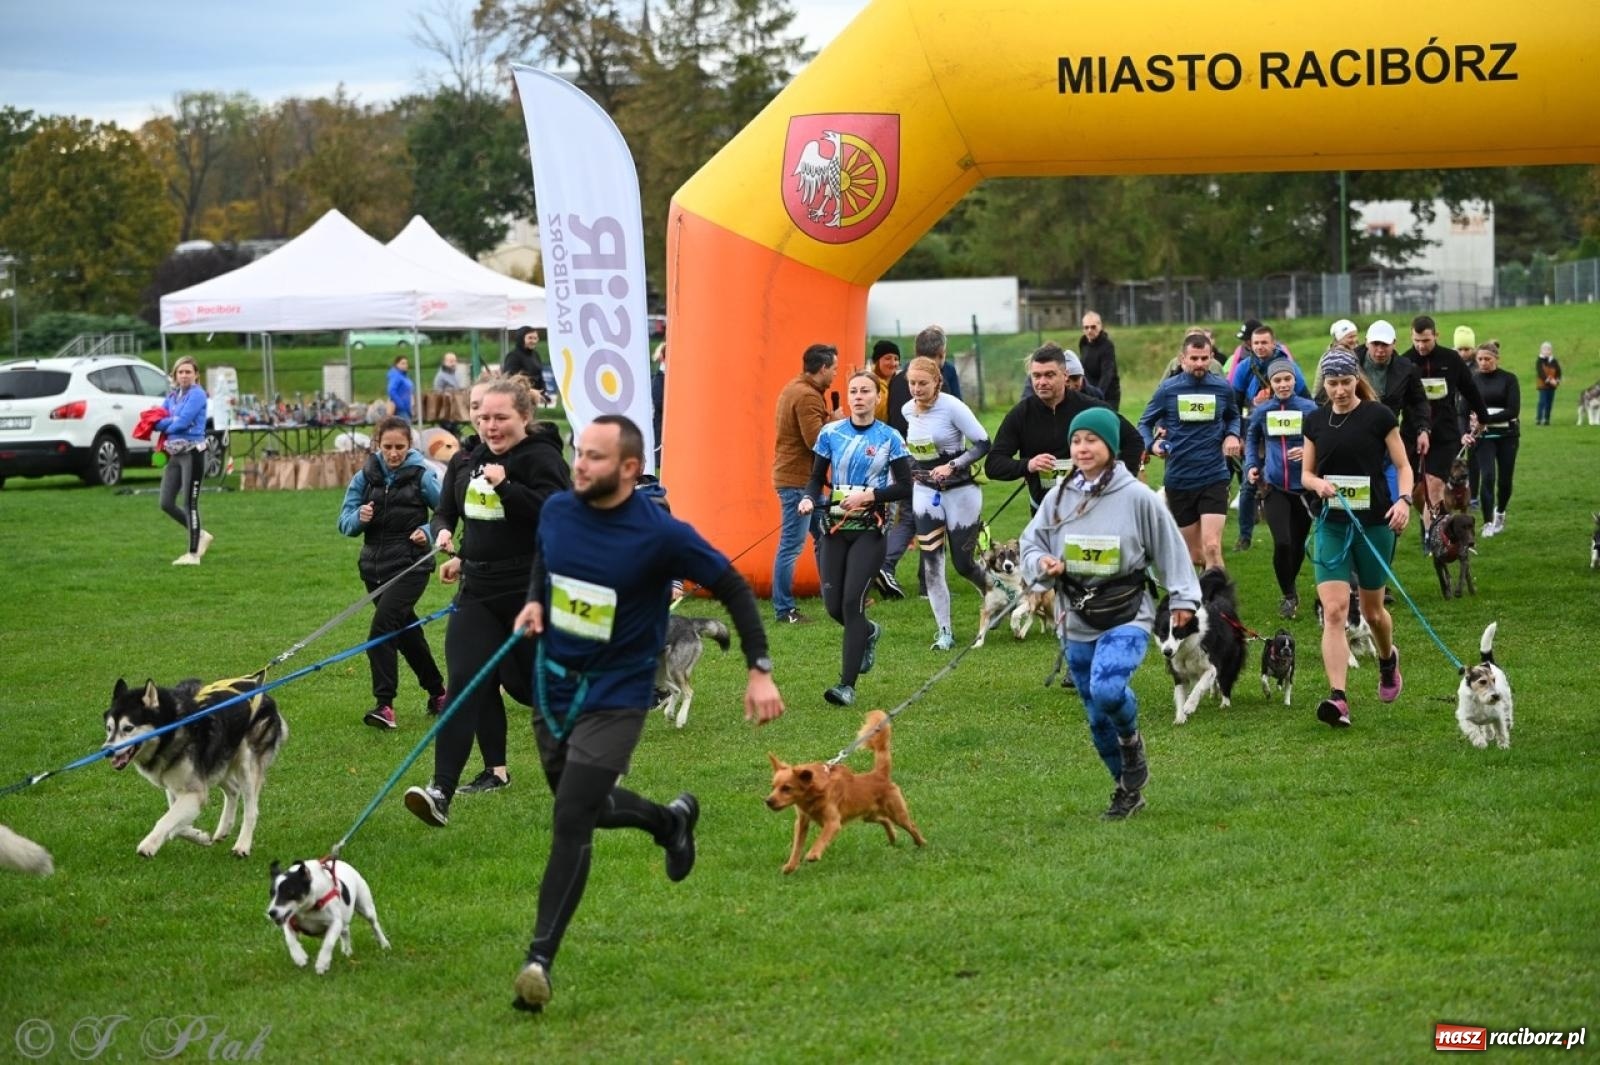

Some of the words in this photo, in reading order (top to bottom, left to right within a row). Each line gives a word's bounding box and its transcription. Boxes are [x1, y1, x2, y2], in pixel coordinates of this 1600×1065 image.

[1058, 53, 1242, 94] MIASTO
[1260, 37, 1518, 89] RACIBÓRZ
[1189, 403, 1205, 412] 26
[1278, 419, 1291, 427] 10
[480, 493, 486, 505] 3
[1082, 549, 1102, 561] 37
[569, 600, 591, 618] 12
